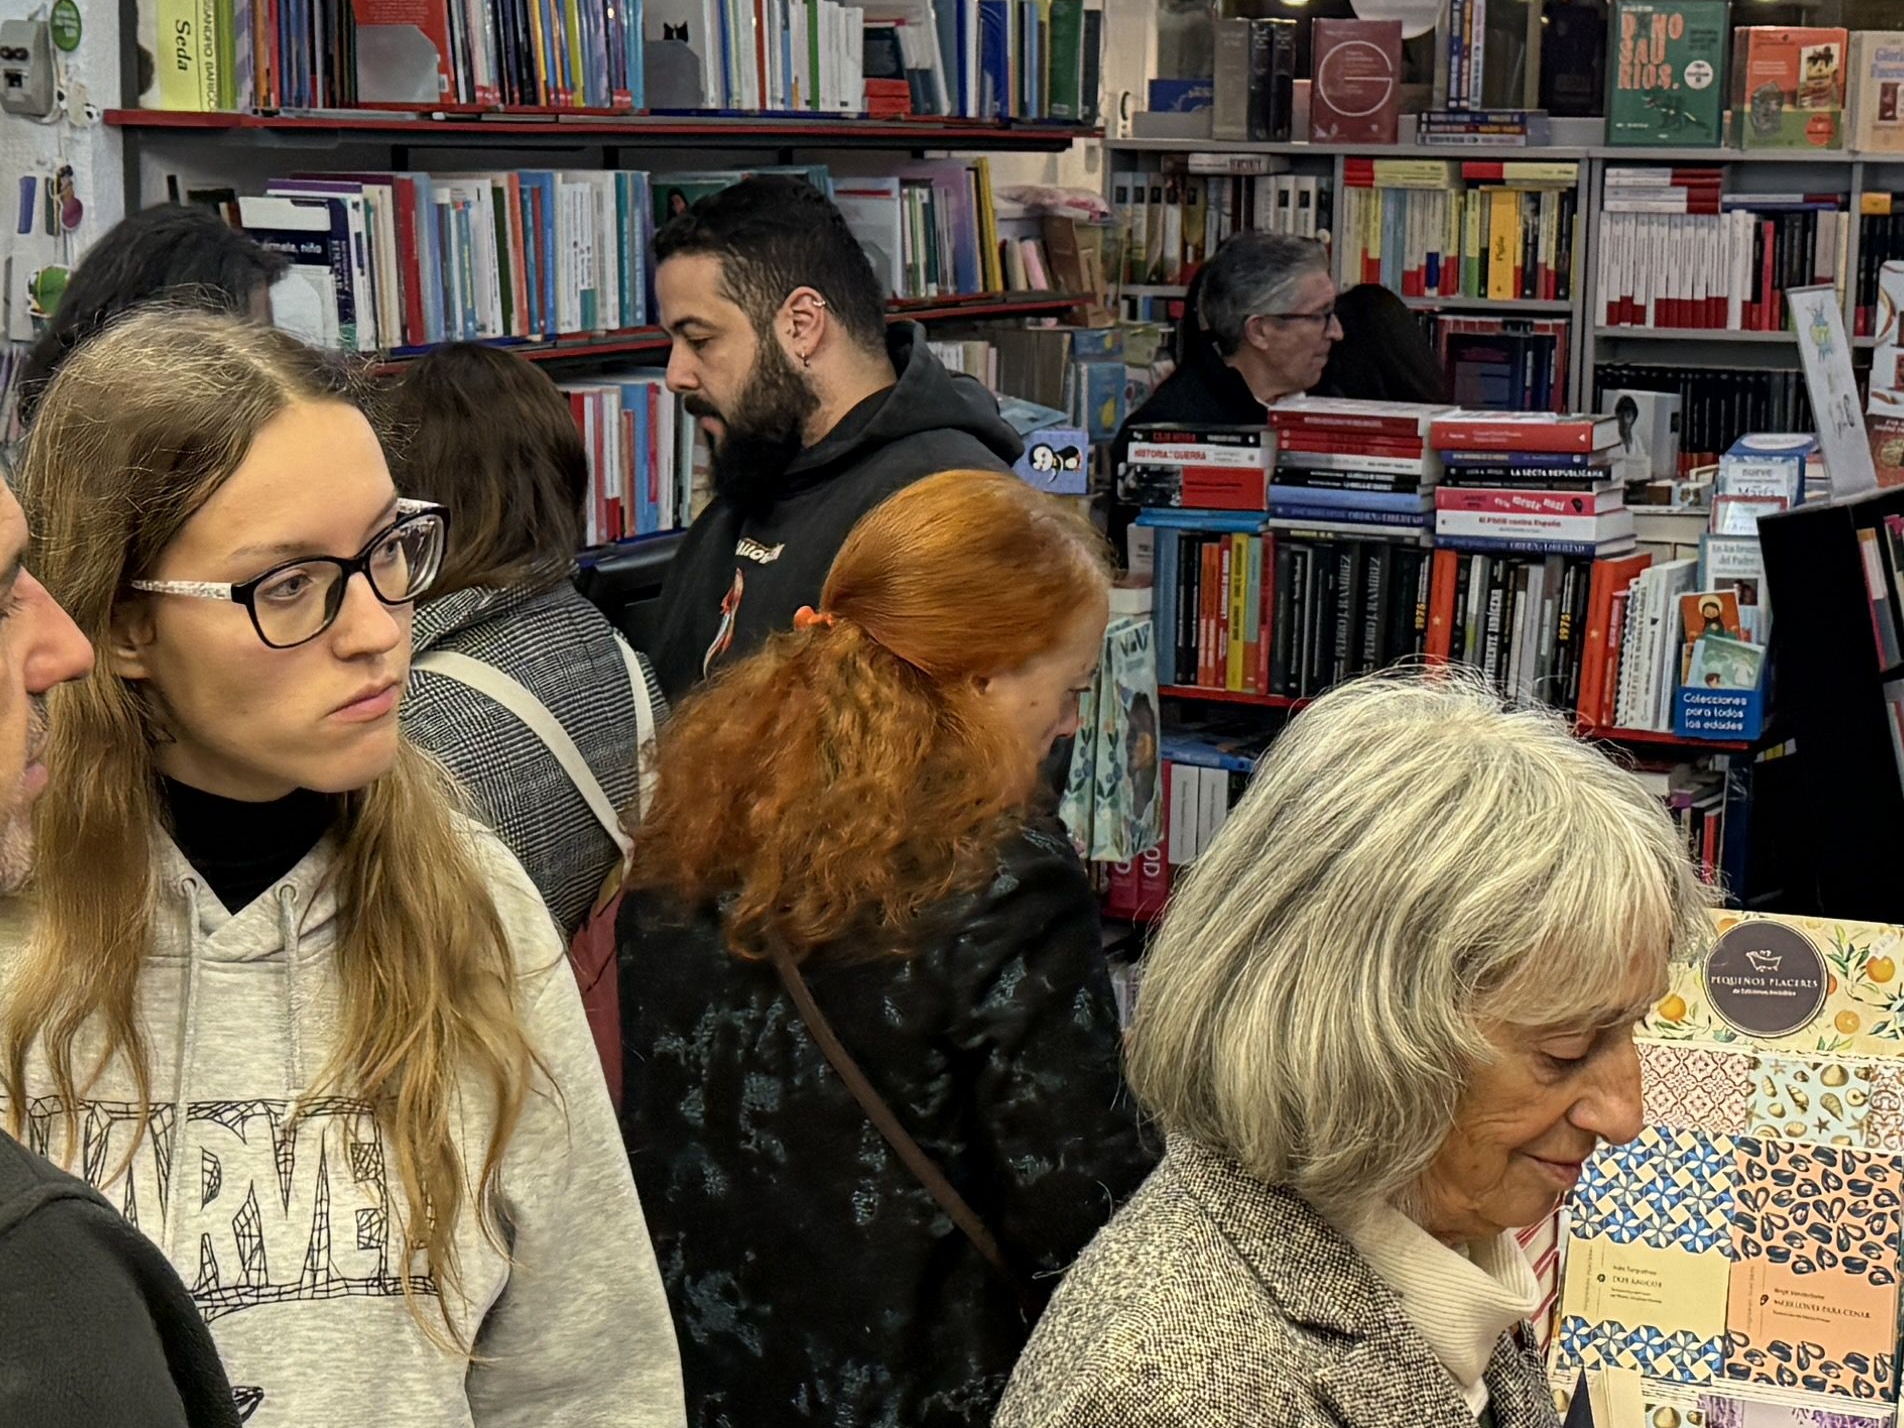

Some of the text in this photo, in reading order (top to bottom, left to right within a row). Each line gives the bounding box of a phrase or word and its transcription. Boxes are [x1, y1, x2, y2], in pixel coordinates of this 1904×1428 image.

[176, 19, 191, 72] Seda
[1619, 37, 1667, 65] SAU
[1618, 63, 1680, 90] RIOS.
[1683, 691, 1748, 707] Colecciones
[1685, 706, 1745, 719] para todos
[1685, 718, 1744, 731] los edades
